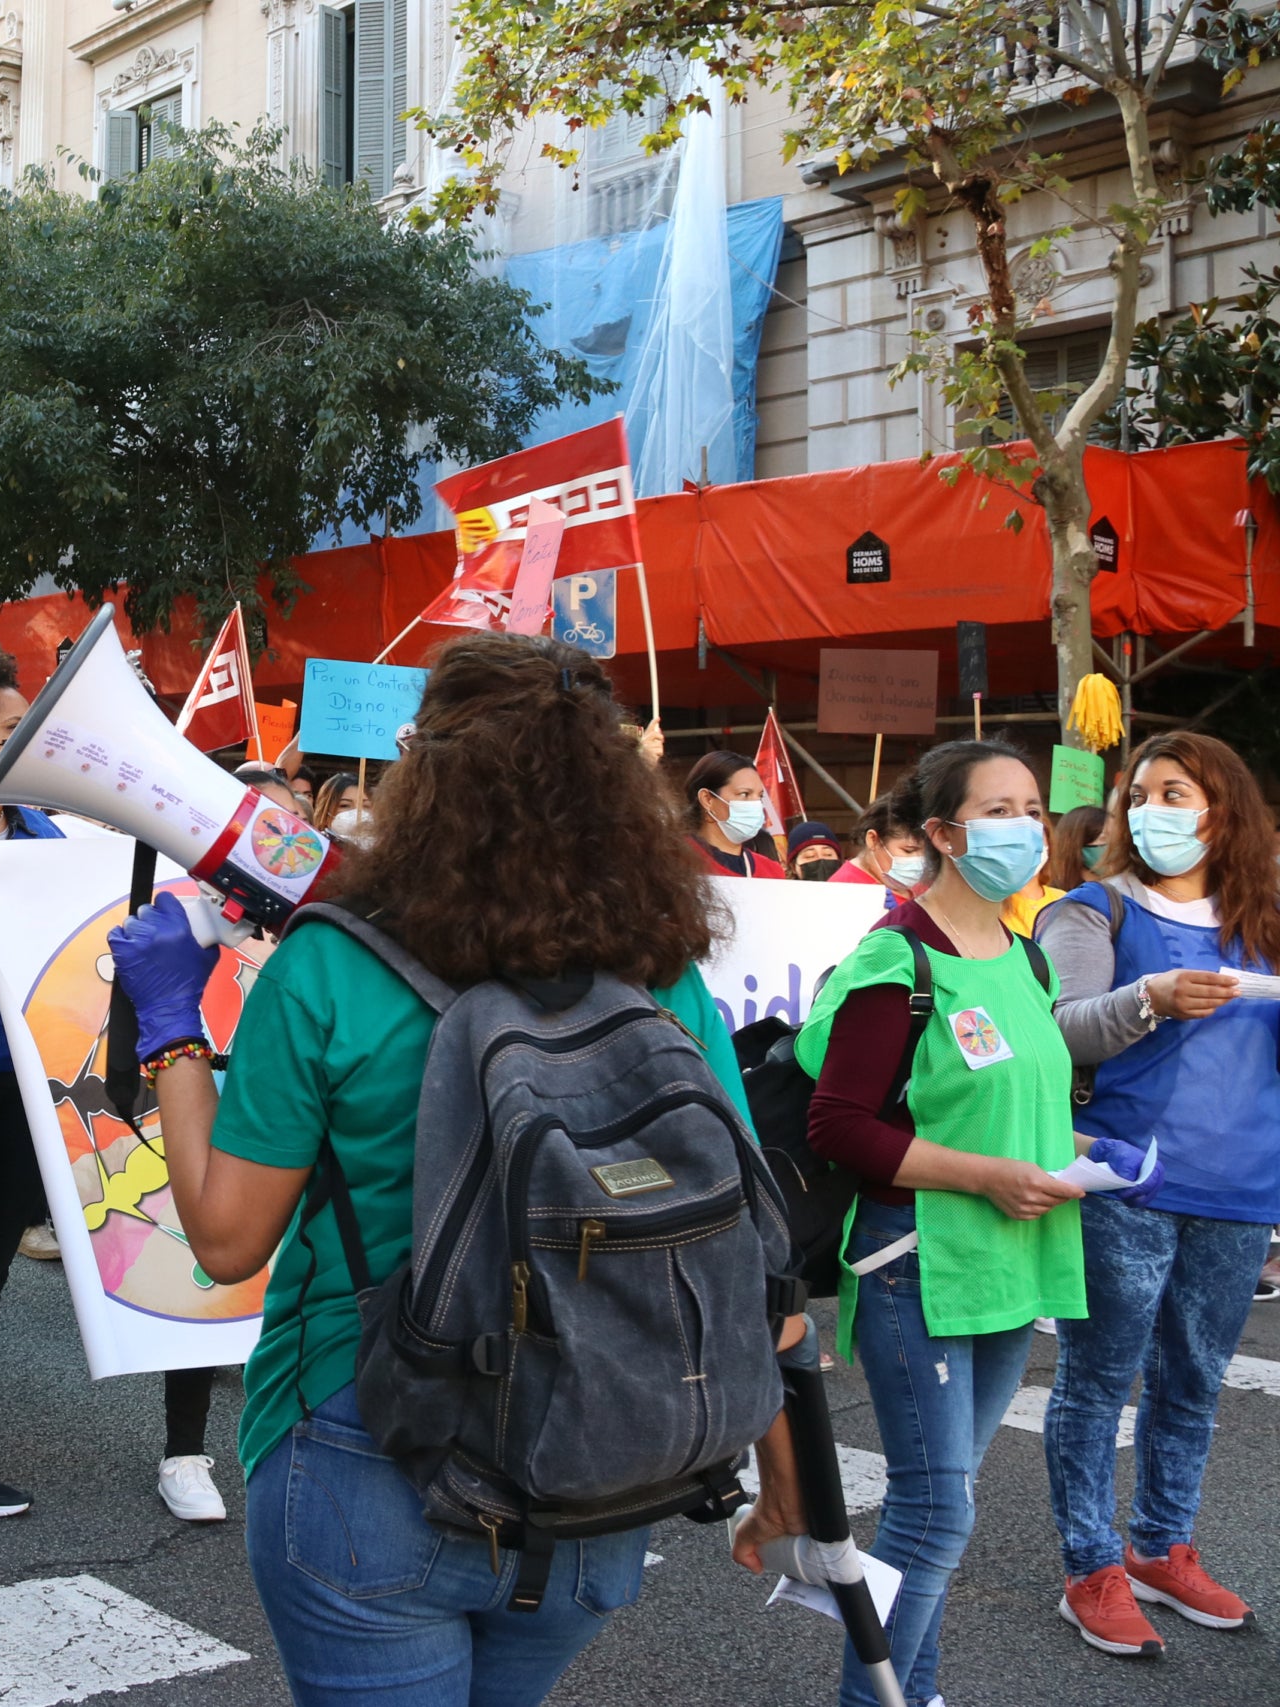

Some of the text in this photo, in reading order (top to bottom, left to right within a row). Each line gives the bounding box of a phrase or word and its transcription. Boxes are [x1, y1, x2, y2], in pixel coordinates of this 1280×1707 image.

[853, 557, 883, 567] HOMS
[570, 577, 597, 610] P
[308, 662, 336, 682] Por
[344, 676, 360, 685] un
[328, 692, 385, 713] Digno
[326, 717, 385, 737] Justo
[151, 783, 183, 805] MUET
